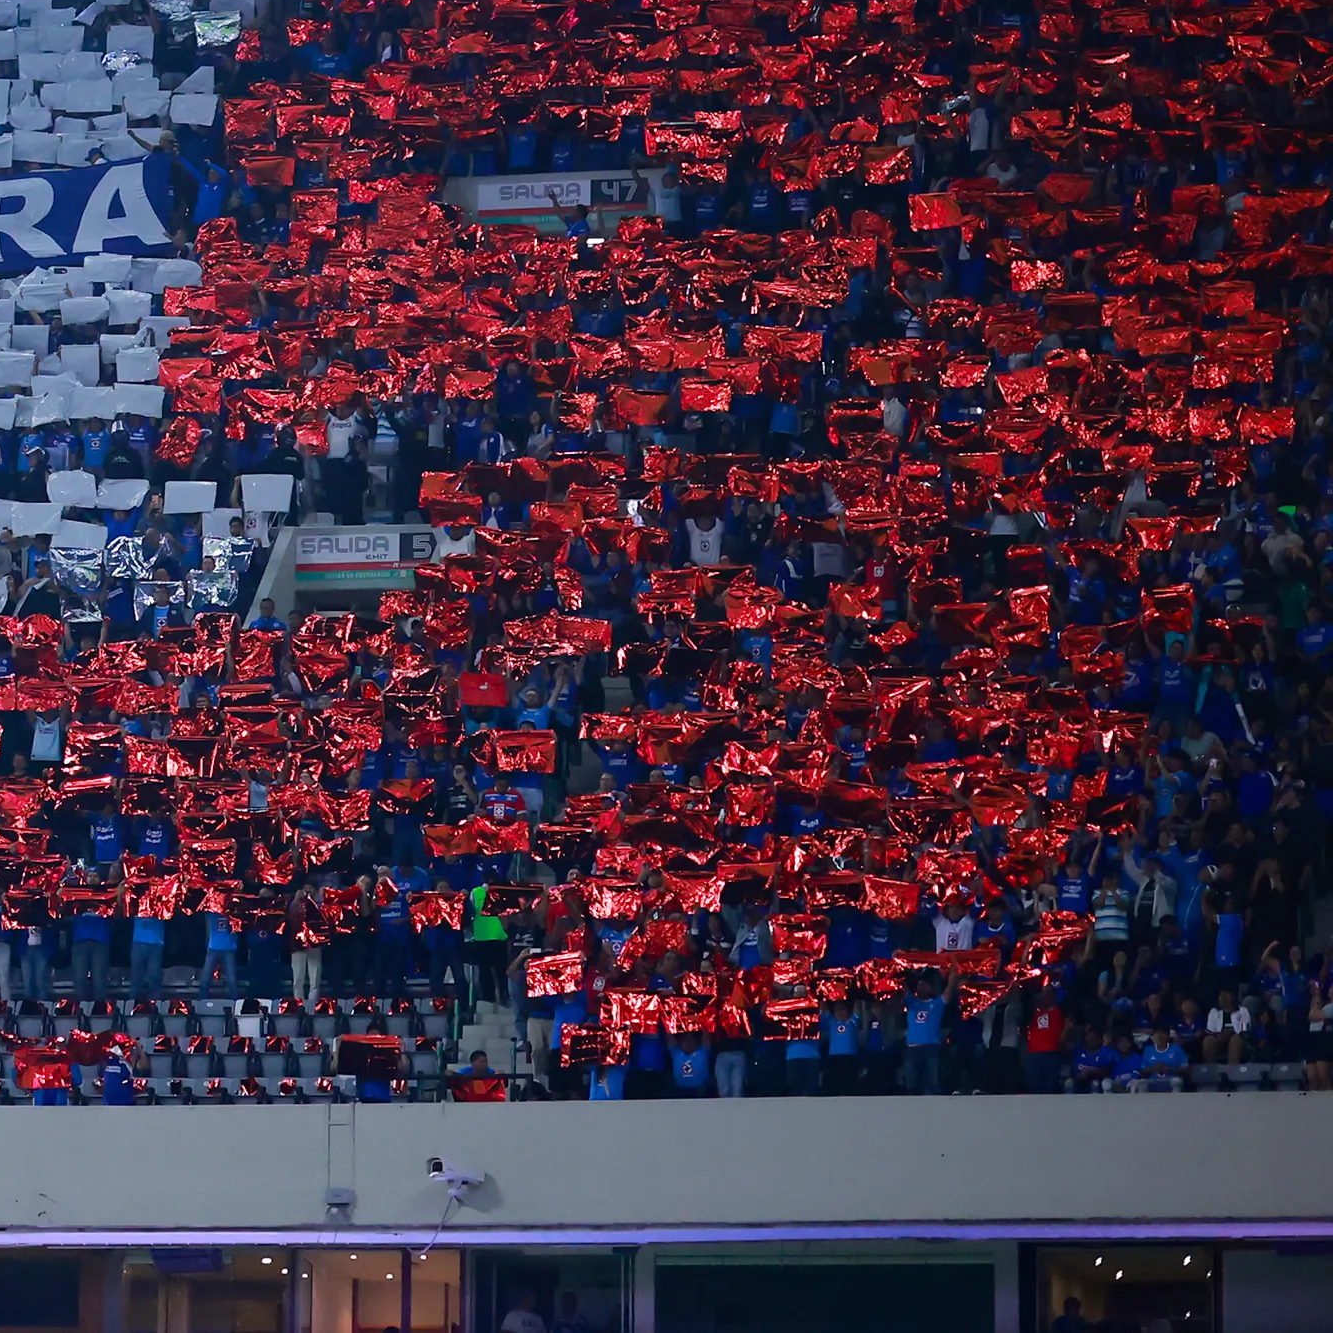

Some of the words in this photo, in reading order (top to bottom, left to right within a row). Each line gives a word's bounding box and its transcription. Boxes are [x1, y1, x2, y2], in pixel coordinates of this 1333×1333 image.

[499, 182, 582, 200] SALIDA
[601, 180, 638, 202] 47
[301, 535, 389, 555] SALIDA
